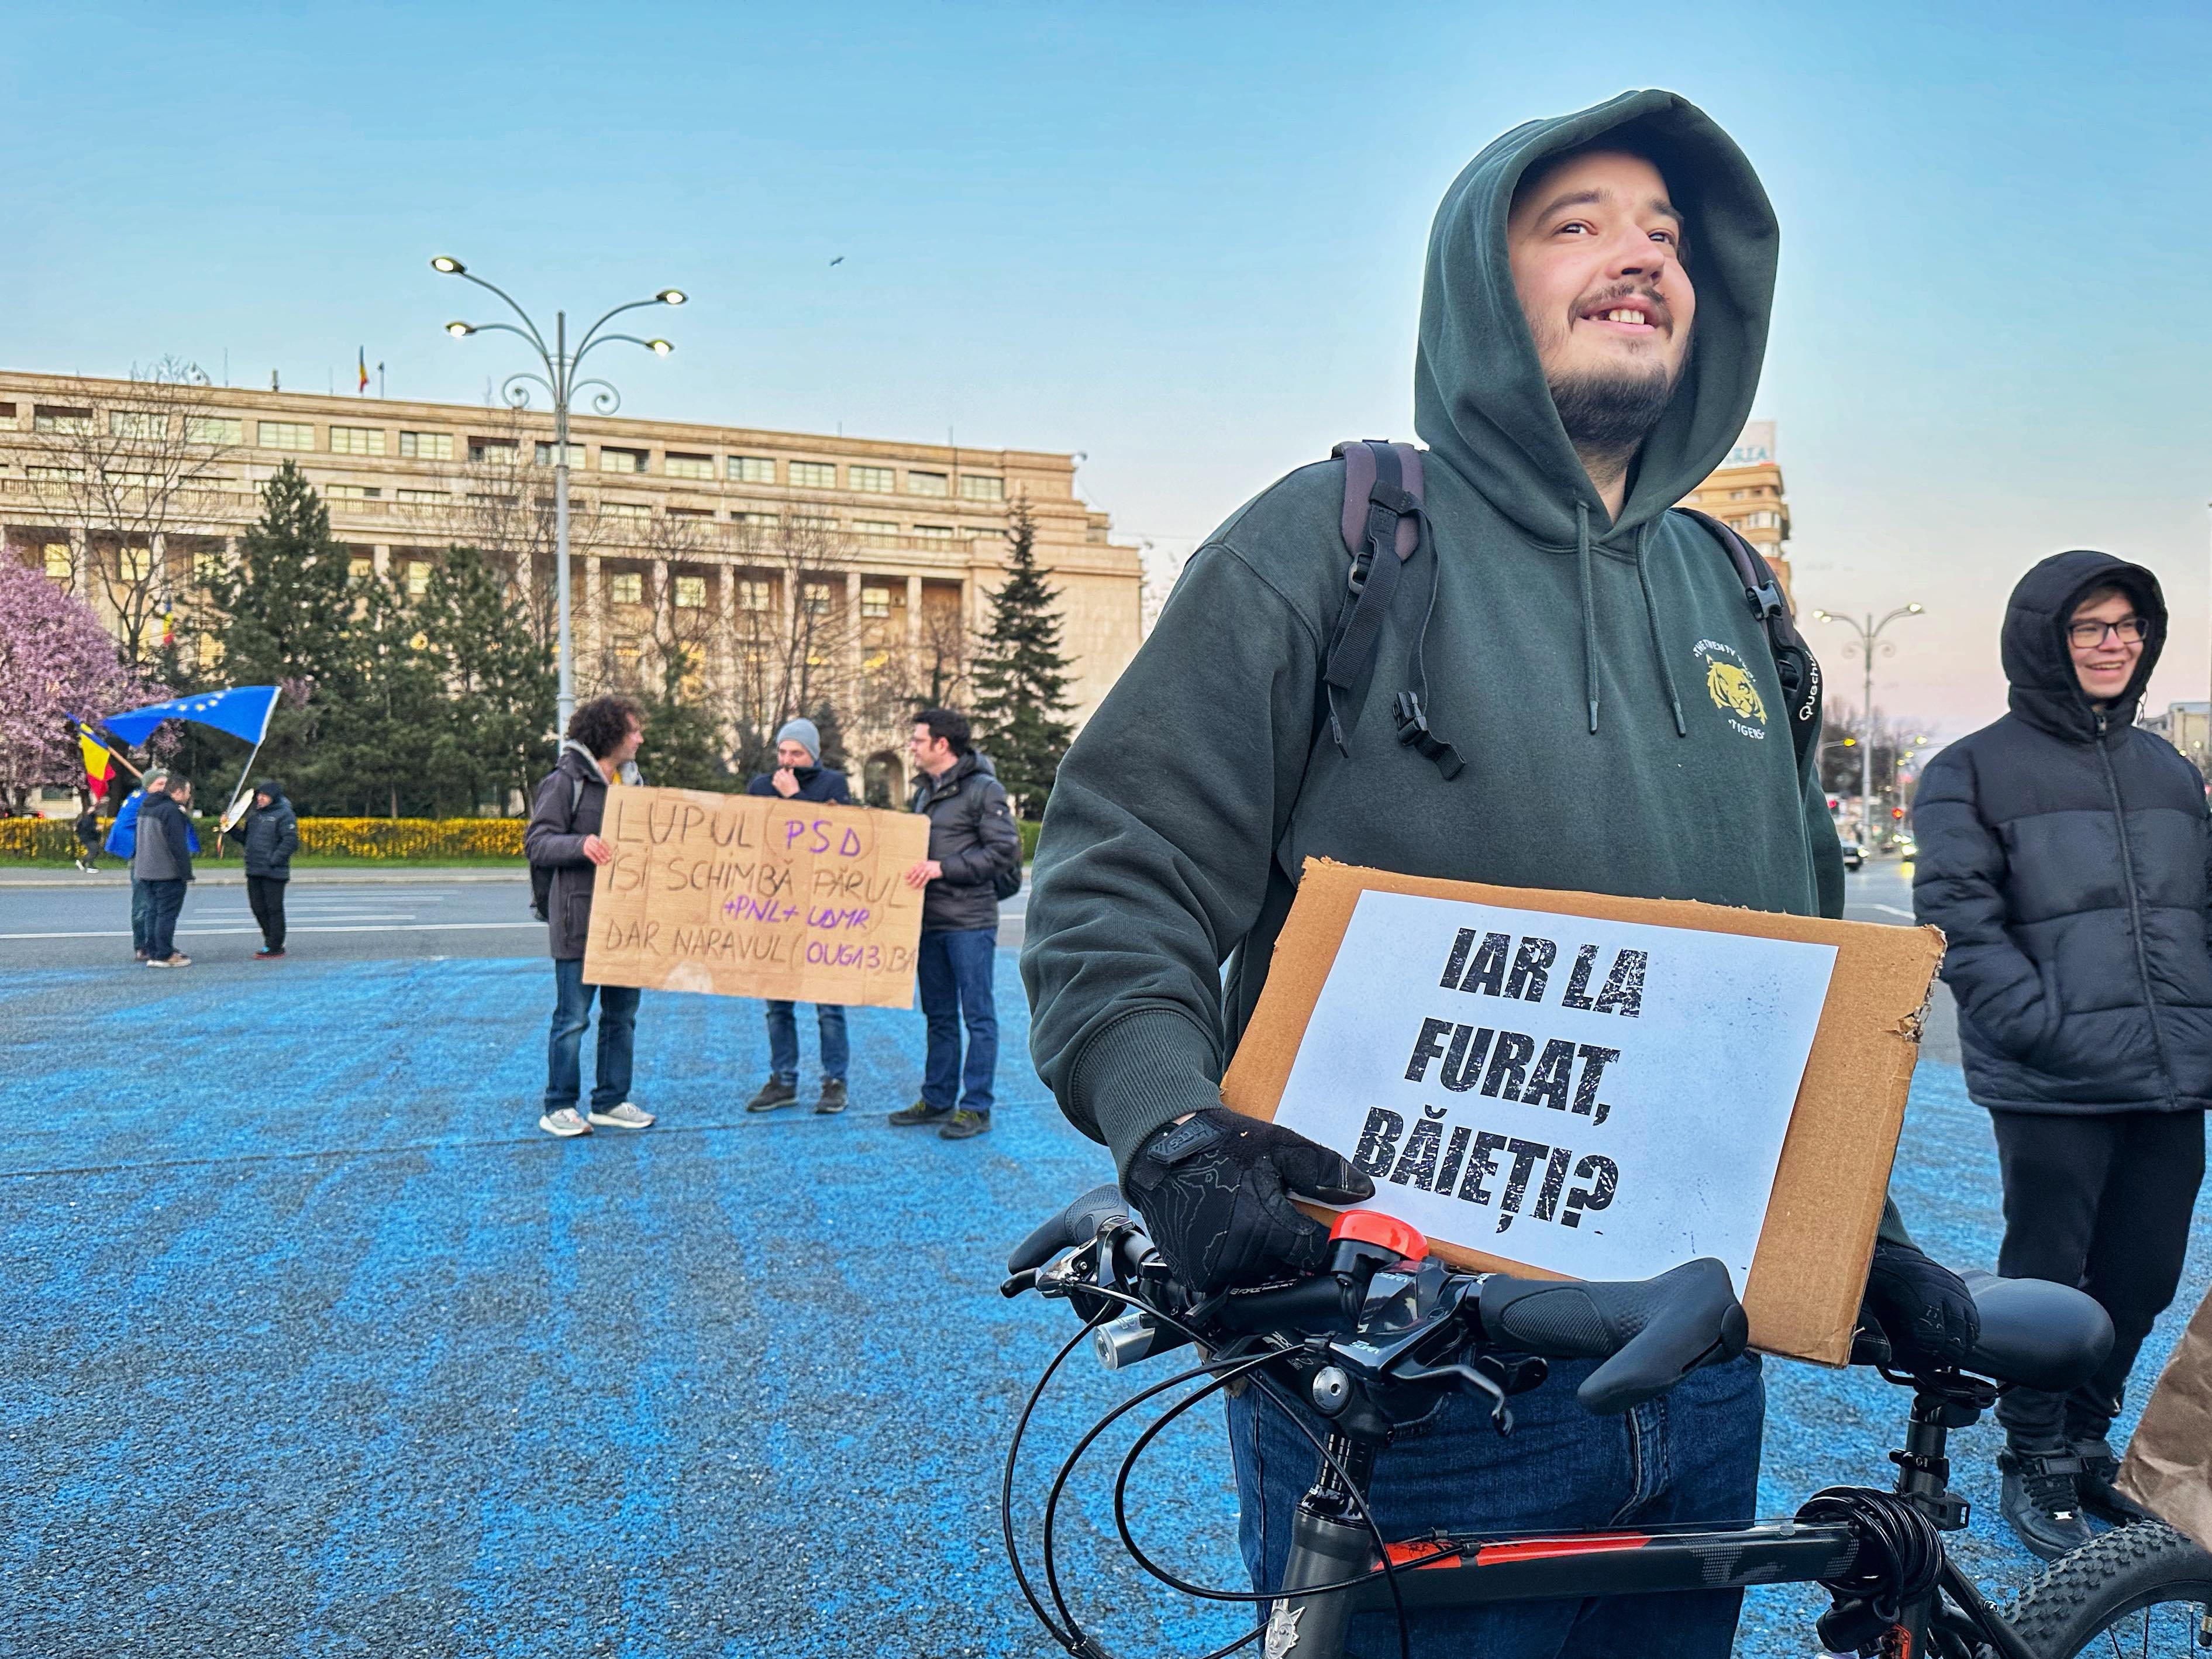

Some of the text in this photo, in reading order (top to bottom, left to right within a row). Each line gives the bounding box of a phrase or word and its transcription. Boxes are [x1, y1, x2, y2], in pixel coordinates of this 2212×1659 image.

[617, 798, 754, 849] LUPUL
[813, 865, 909, 909] PĂRUL
[605, 918, 661, 956] DAR
[1440, 928, 1648, 1018] IAR LA
[1405, 1017, 1621, 1126] FURAT,
[1352, 1104, 1618, 1234] BĂIEȚI?
